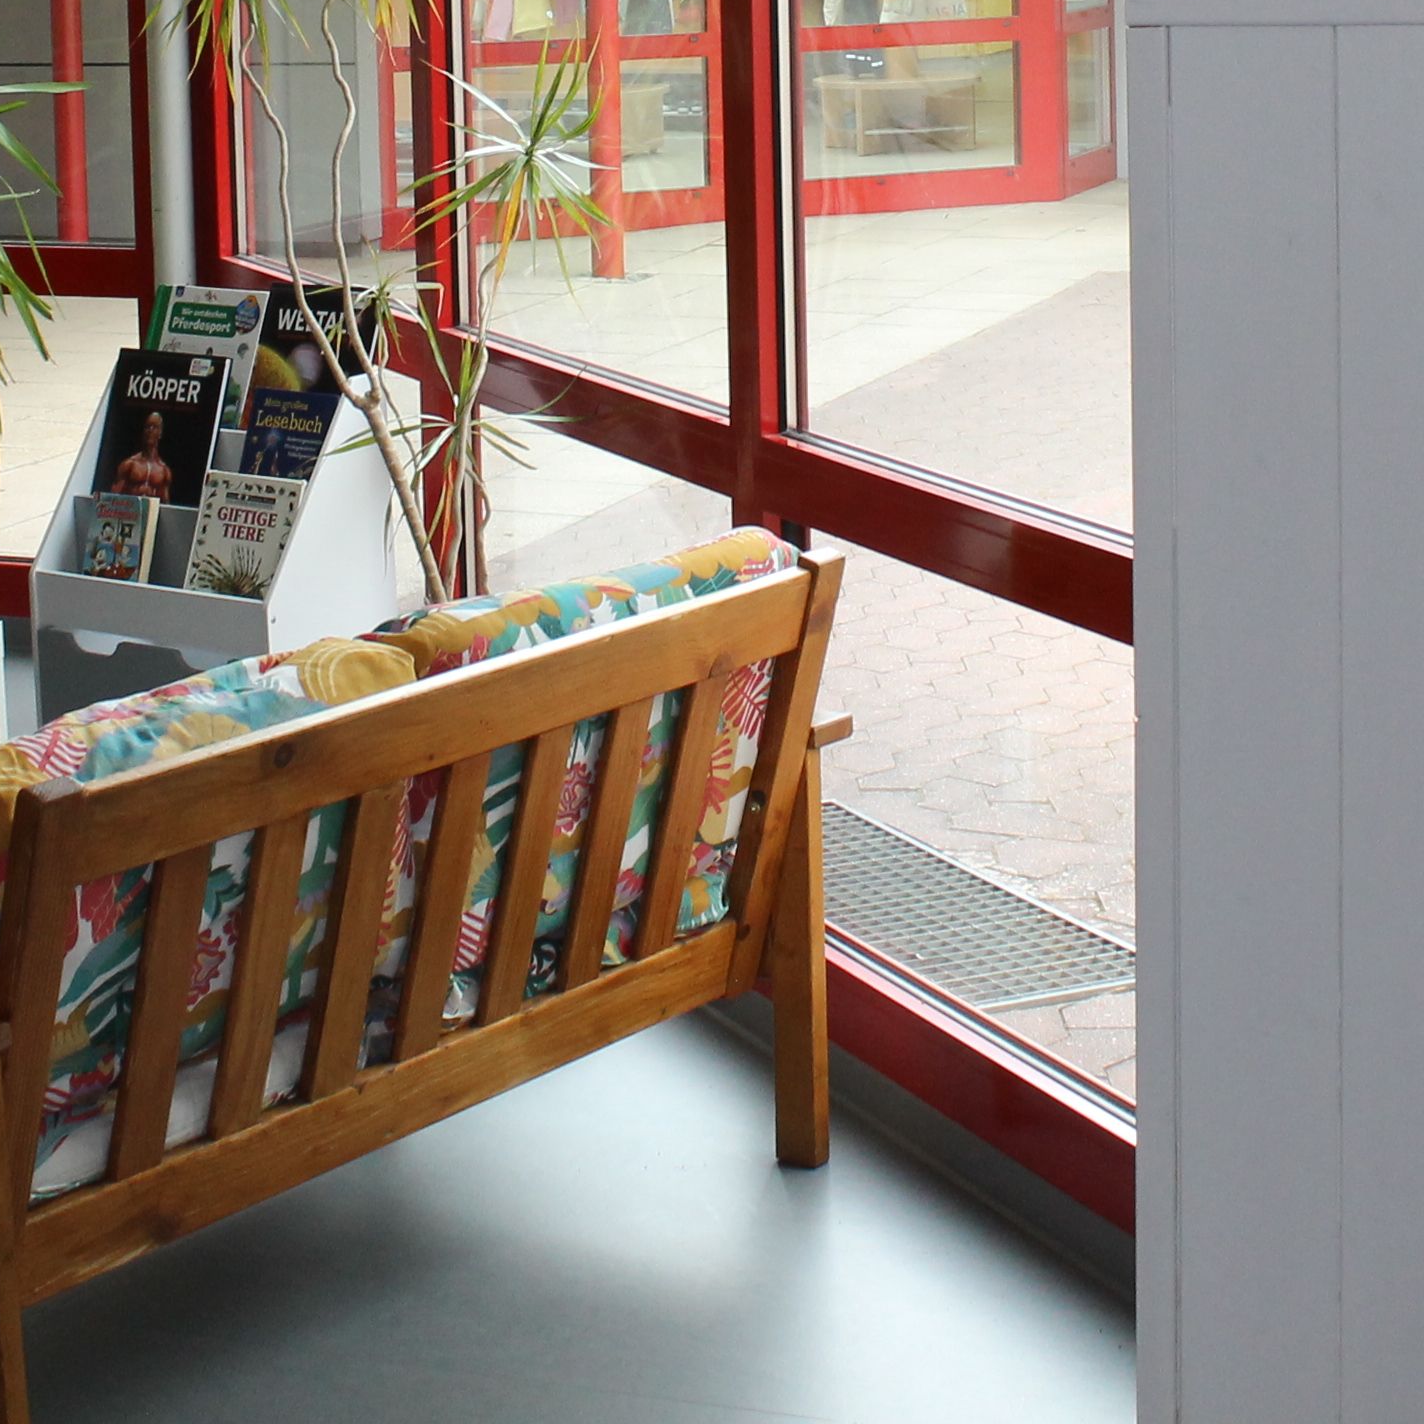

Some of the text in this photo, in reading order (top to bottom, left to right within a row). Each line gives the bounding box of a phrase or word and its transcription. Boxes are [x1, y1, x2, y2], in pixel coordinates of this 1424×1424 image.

[171, 316, 232, 334] Pferdesport
[127, 369, 202, 404] KÖRPER
[256, 409, 323, 434] Lesebuch
[217, 506, 278, 529] GIFTIGE
[222, 522, 267, 544] TIERE
